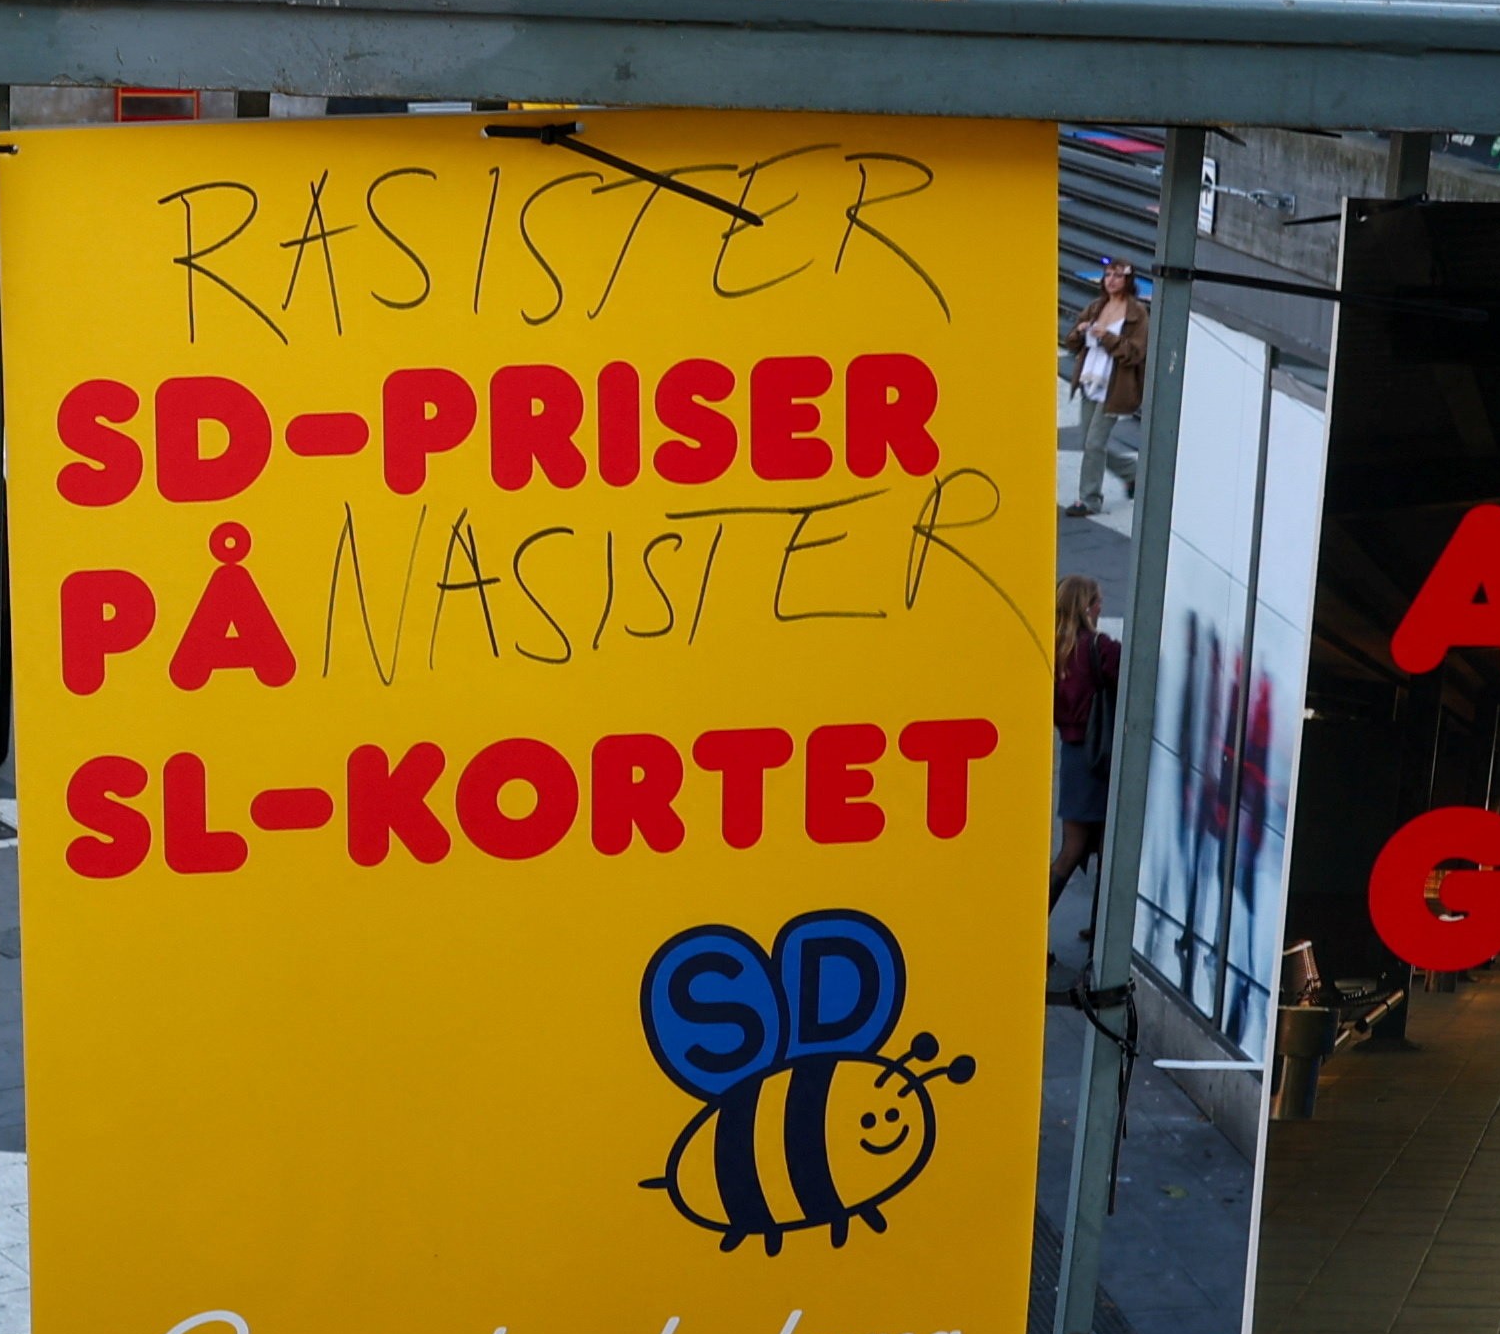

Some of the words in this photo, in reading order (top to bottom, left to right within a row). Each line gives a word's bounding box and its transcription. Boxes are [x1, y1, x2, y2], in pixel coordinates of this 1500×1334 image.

[157, 142, 952, 345] RASISTER
[56, 351, 941, 509] SD-PRISER
[59, 521, 298, 696] PÅ
[323, 465, 1055, 686] NASISTER
[64, 717, 999, 880] SL-KORTET
[667, 937, 880, 1074] SD
